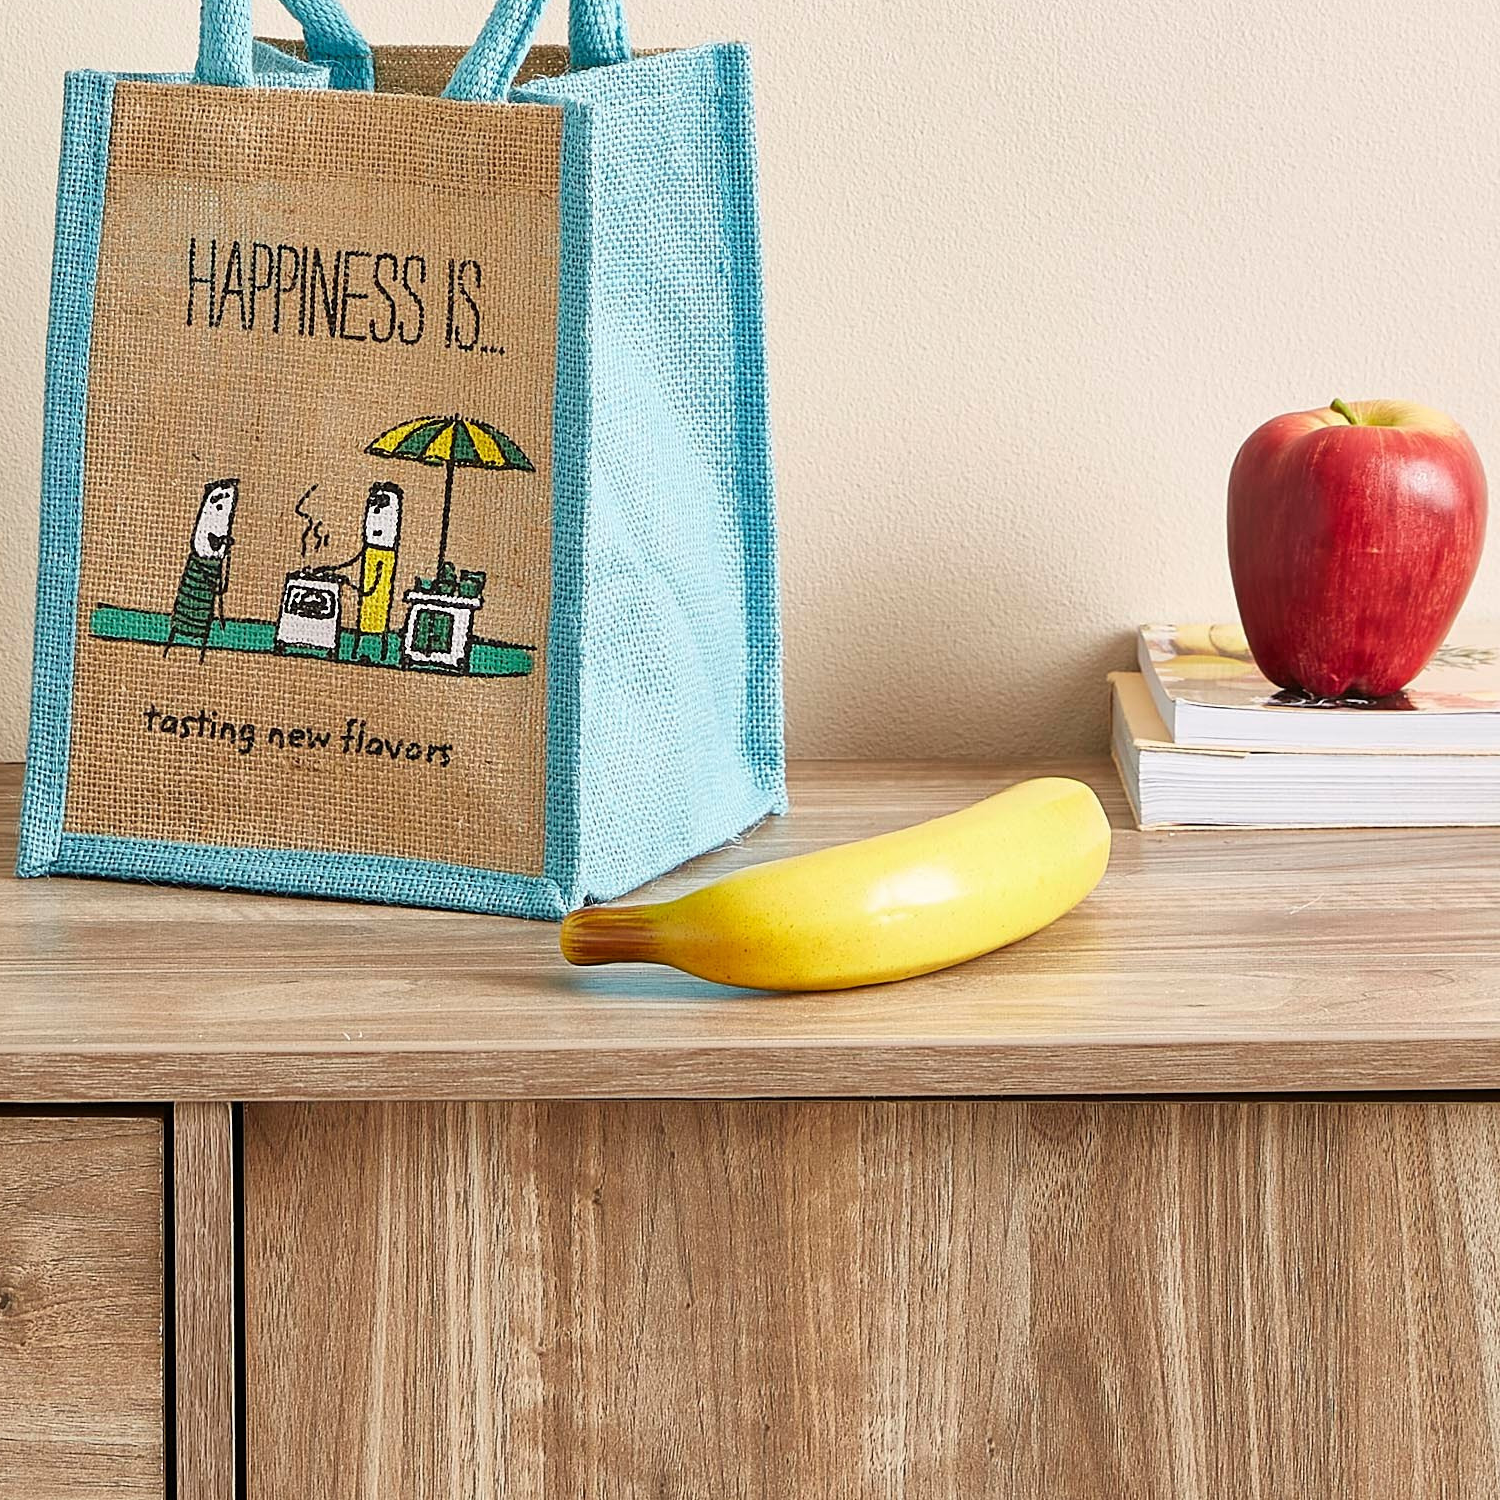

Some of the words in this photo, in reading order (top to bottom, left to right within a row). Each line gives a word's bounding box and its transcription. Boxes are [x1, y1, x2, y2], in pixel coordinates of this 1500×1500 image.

[186, 238, 426, 345] HAPPINESS
[444, 258, 505, 355] IS...
[143, 704, 255, 754] tasting
[268, 726, 331, 749] new
[340, 719, 453, 767] flavors
